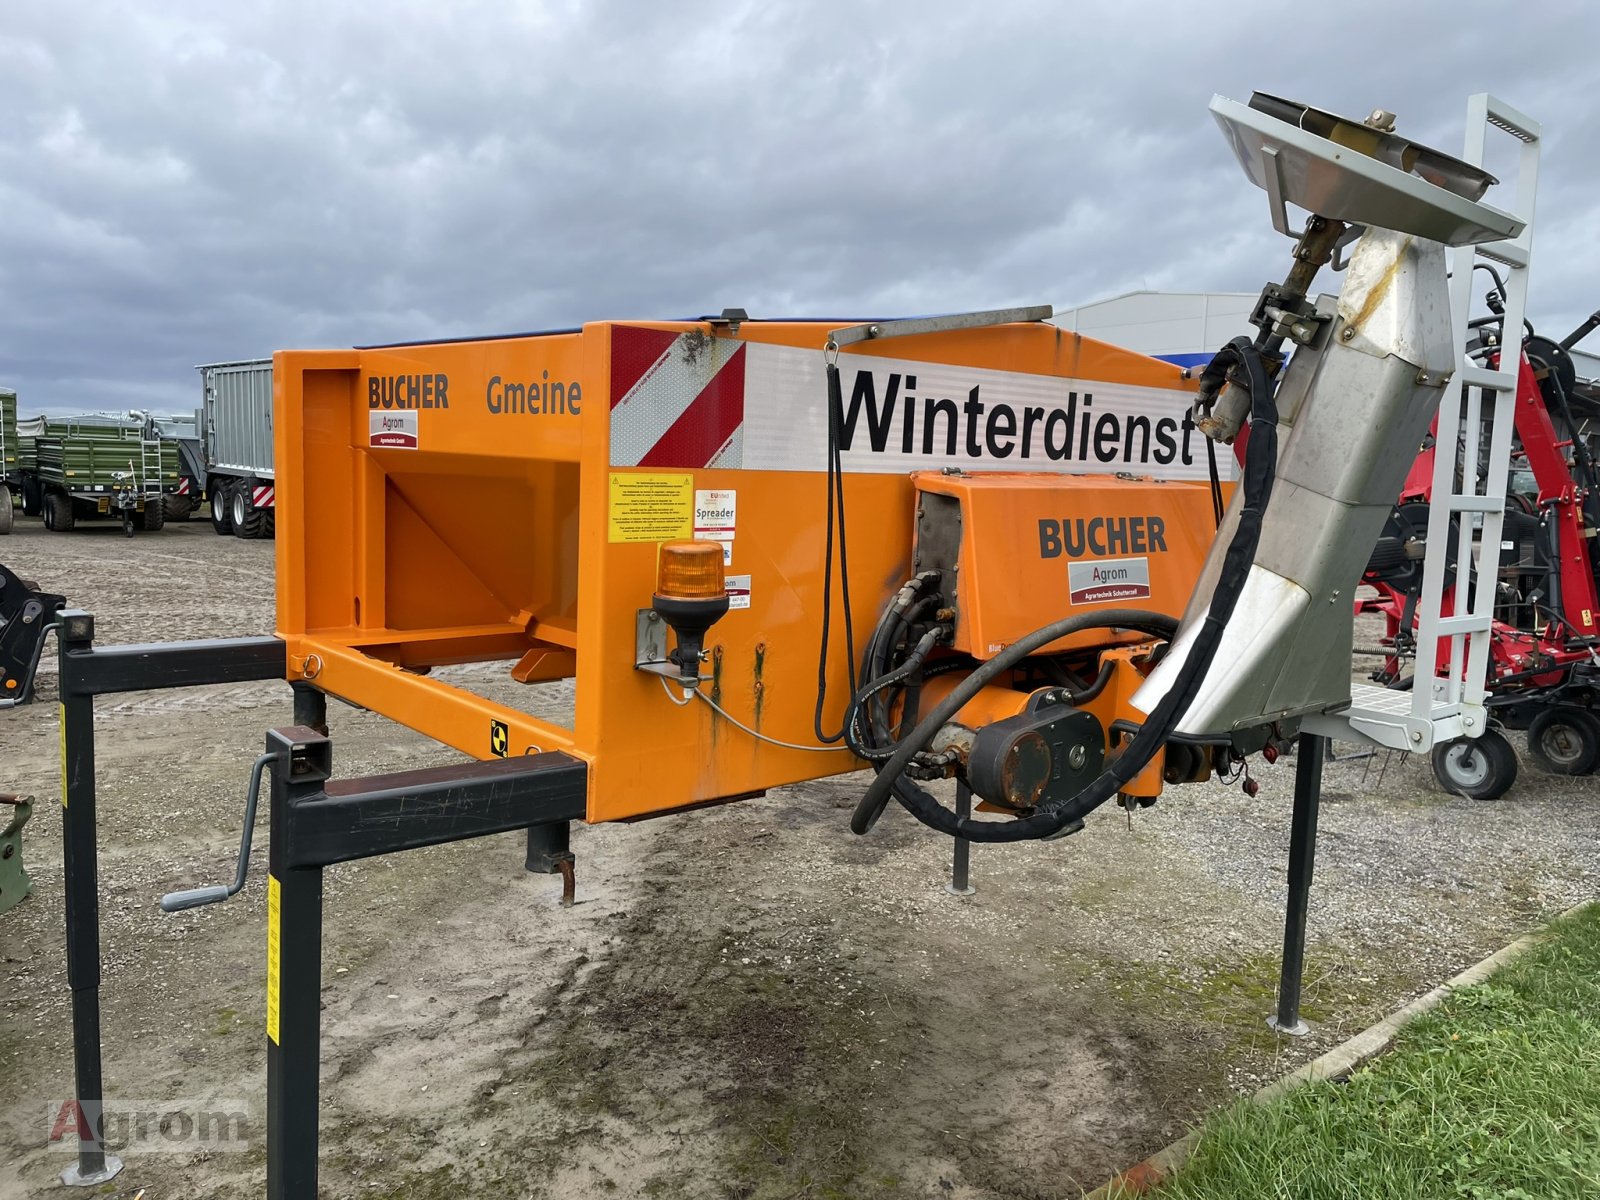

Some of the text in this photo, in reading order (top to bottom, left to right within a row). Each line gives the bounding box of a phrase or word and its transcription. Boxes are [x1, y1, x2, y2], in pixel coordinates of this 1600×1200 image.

[368, 373, 449, 409] BUCHER
[487, 370, 582, 416] Gmeine
[382, 415, 404, 431] Agrom
[834, 367, 1196, 465] Winterdienst
[696, 508, 734, 520] Spreader
[1038, 516, 1168, 559] BUCHER
[1092, 567, 1128, 584] Agrom
[1085, 590, 1112, 600] Agrartechnik
